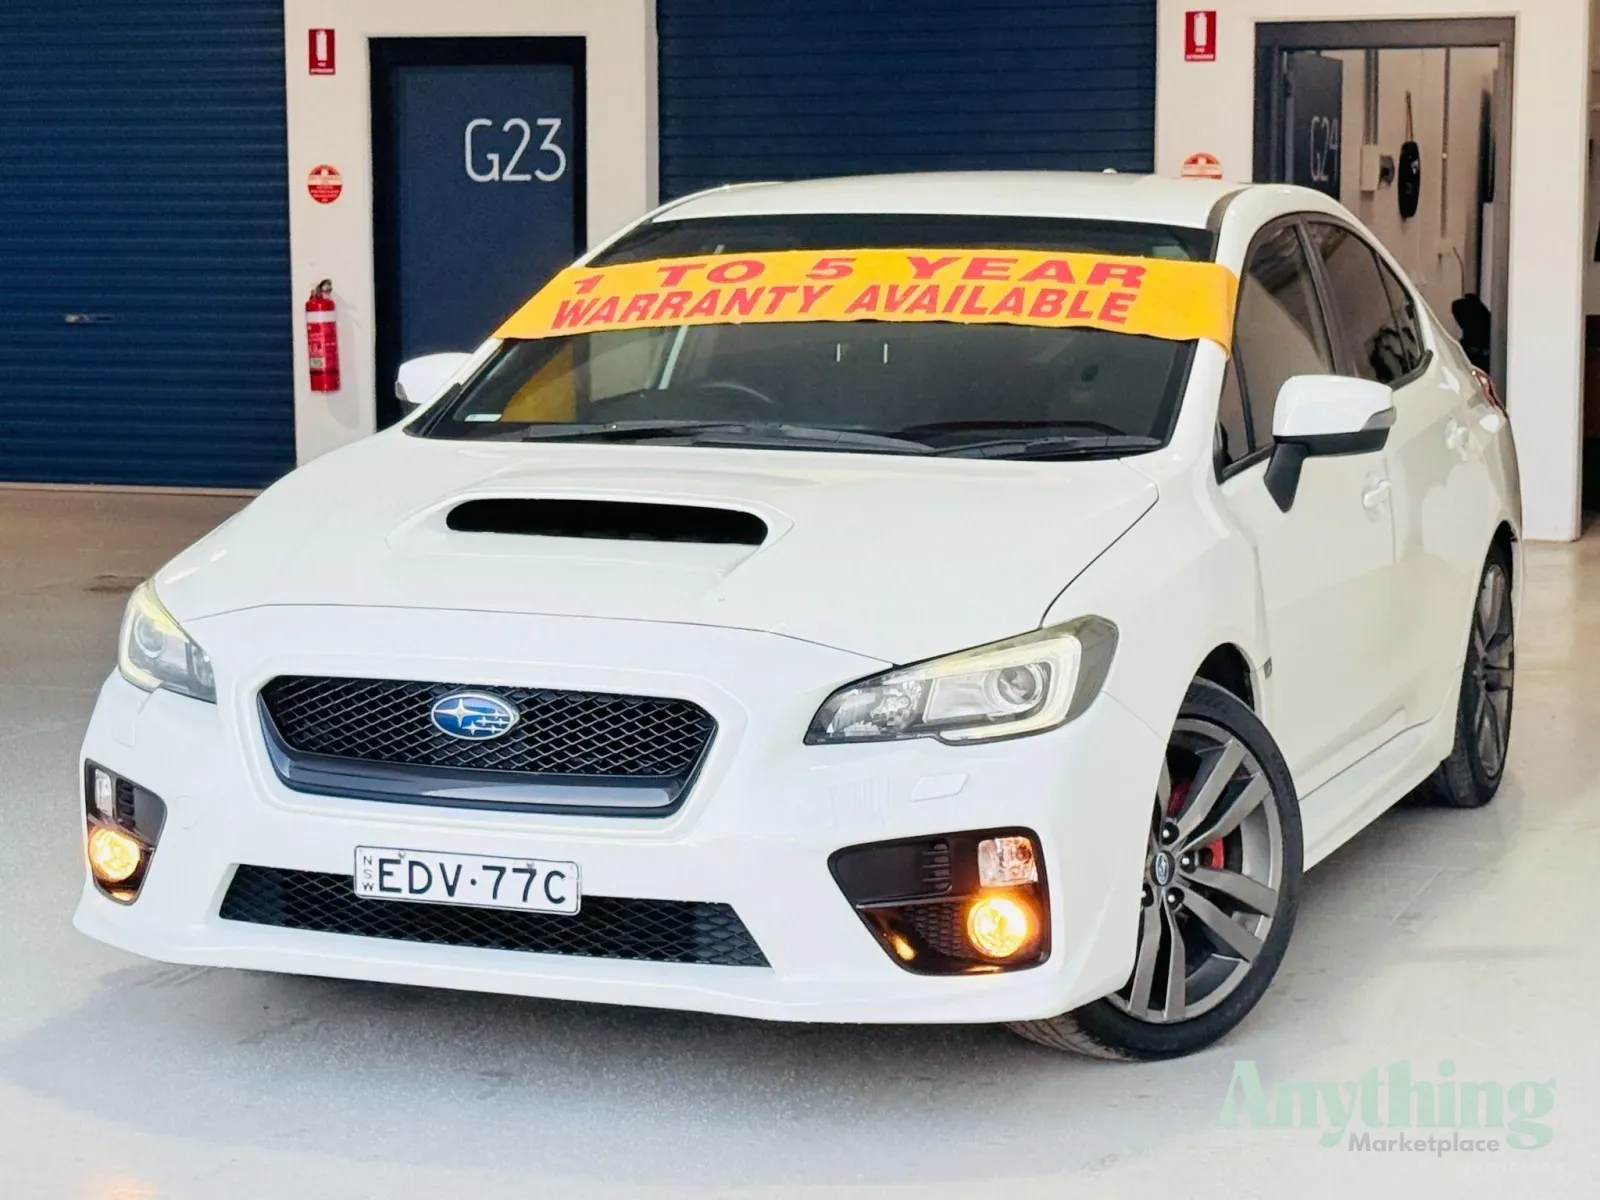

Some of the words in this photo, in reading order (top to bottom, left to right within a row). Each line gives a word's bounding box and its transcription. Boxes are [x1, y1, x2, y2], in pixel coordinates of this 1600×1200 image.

[465, 118, 567, 182] G23
[1310, 115, 1338, 182] G24
[573, 274, 605, 295] 1
[657, 260, 766, 287] TO
[805, 258, 858, 280] 5
[907, 256, 1147, 288] YEAR
[551, 285, 833, 329] WARRANTY
[843, 284, 1137, 324] AVAILABLE
[362, 855, 375, 892] NSW
